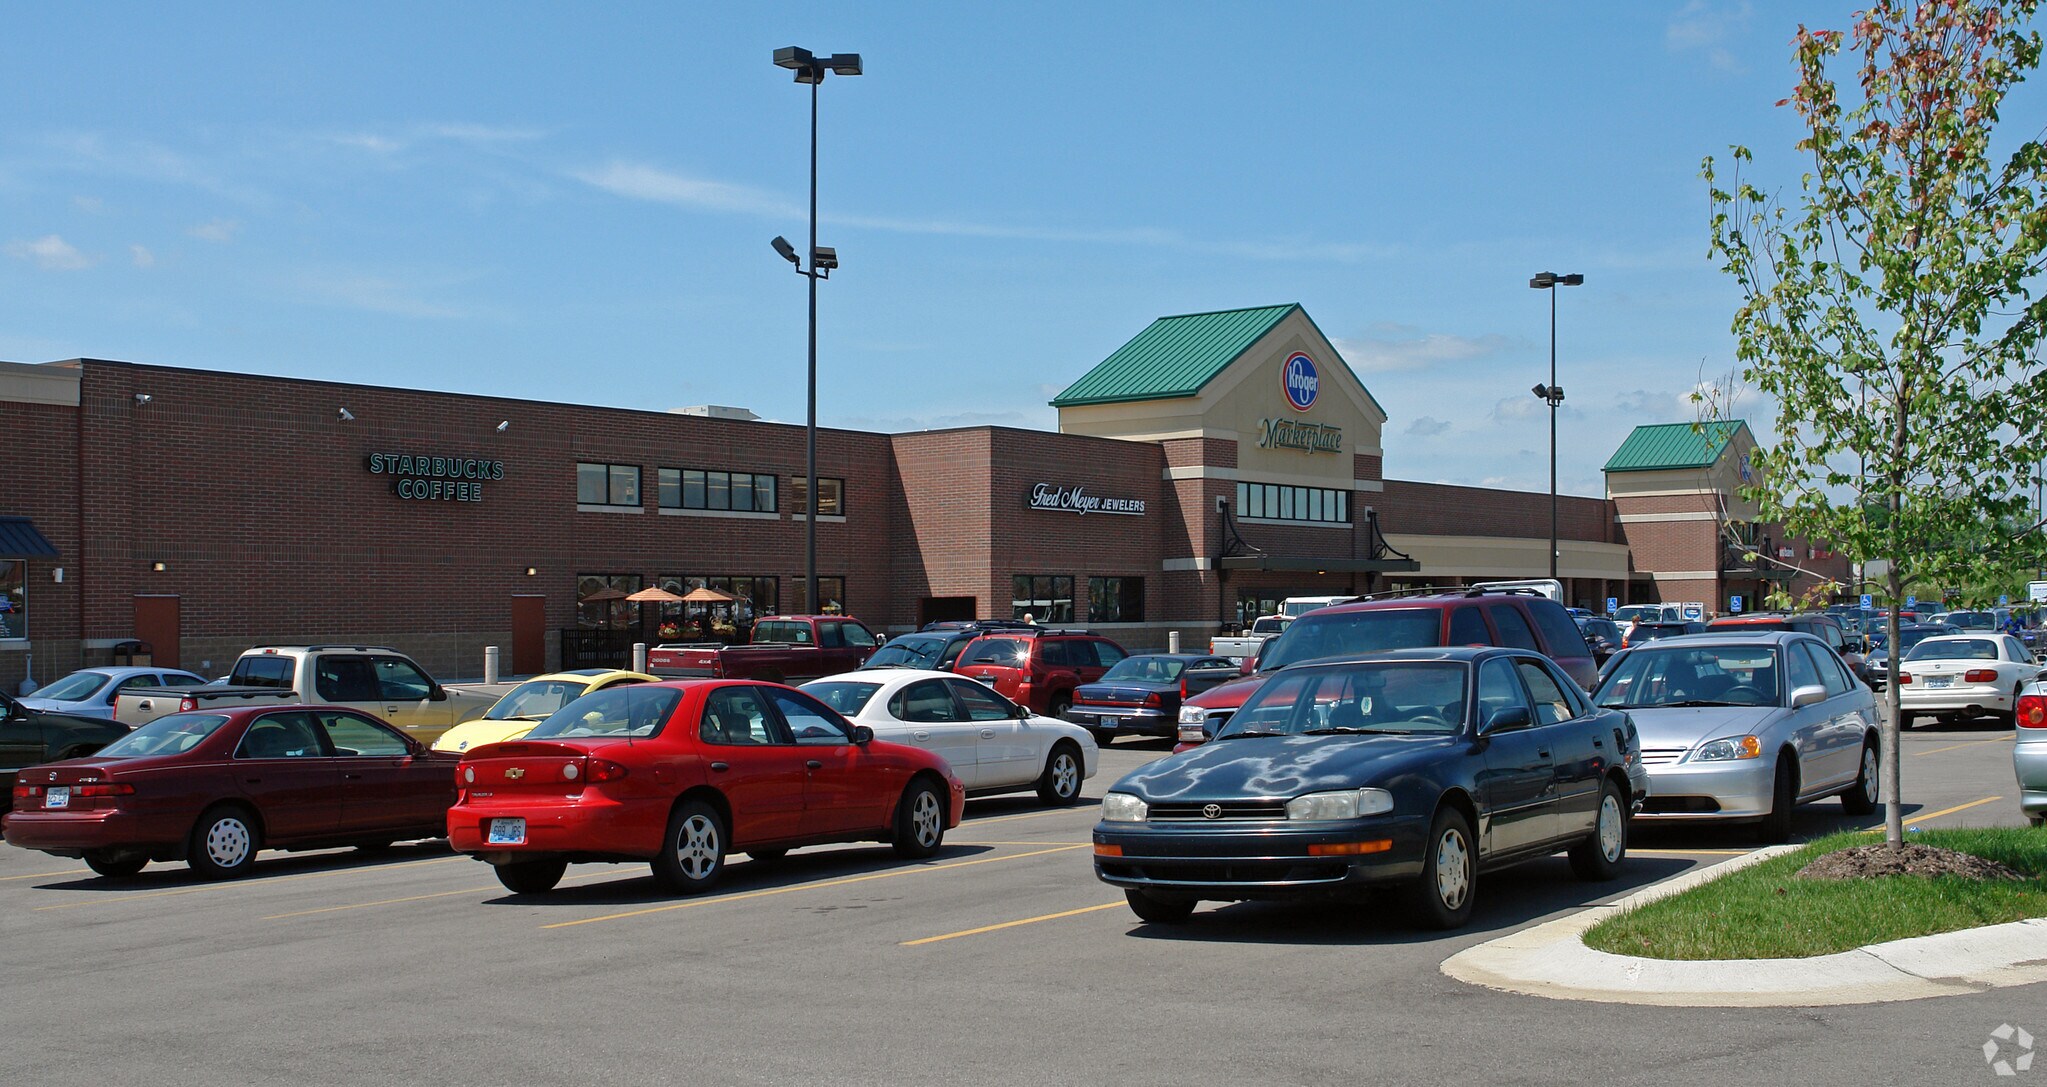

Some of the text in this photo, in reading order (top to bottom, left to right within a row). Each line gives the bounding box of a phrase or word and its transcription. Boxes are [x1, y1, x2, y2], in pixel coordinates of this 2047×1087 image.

[1288, 360, 1318, 404] Kroger
[1260, 418, 1342, 454] Marketplace
[370, 452, 504, 481] STARBUCKS
[397, 478, 482, 502] COFFEE
[1030, 482, 1145, 515] Fred Meyer JEWELERS
